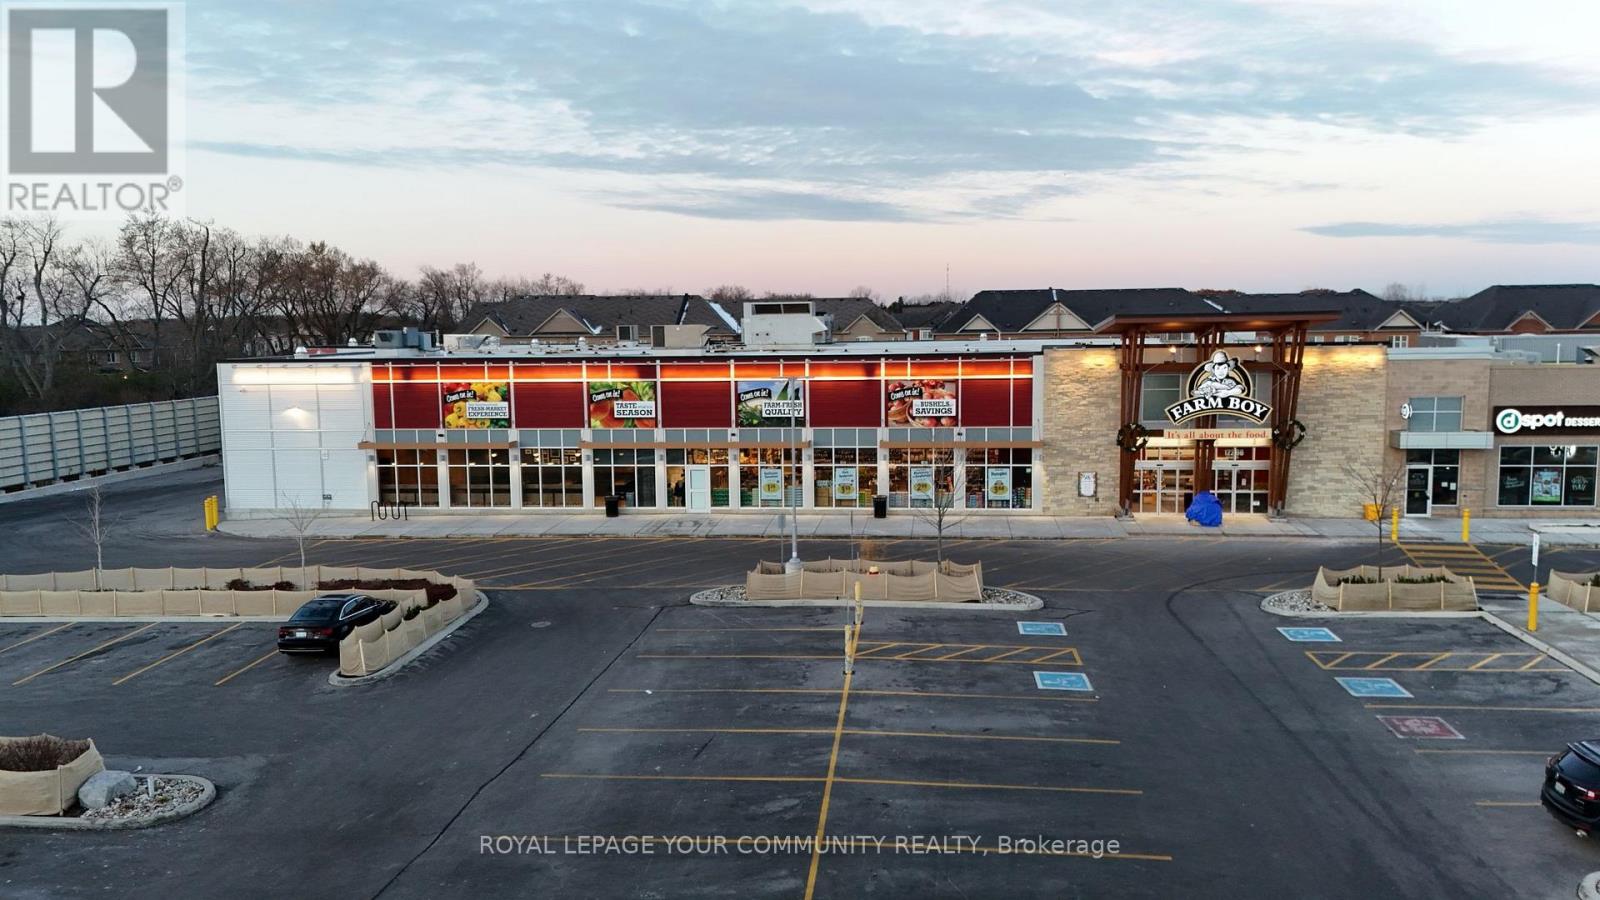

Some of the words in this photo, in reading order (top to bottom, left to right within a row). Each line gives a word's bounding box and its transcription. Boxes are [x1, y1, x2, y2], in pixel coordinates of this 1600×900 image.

[915, 407, 953, 415] SAVINGS
[1170, 397, 1223, 420] FARM
[1228, 397, 1268, 417] BOY
[1167, 431, 1180, 439] It's
[1184, 431, 1195, 439] all
[1199, 431, 1224, 439] about
[1228, 431, 1242, 439] the
